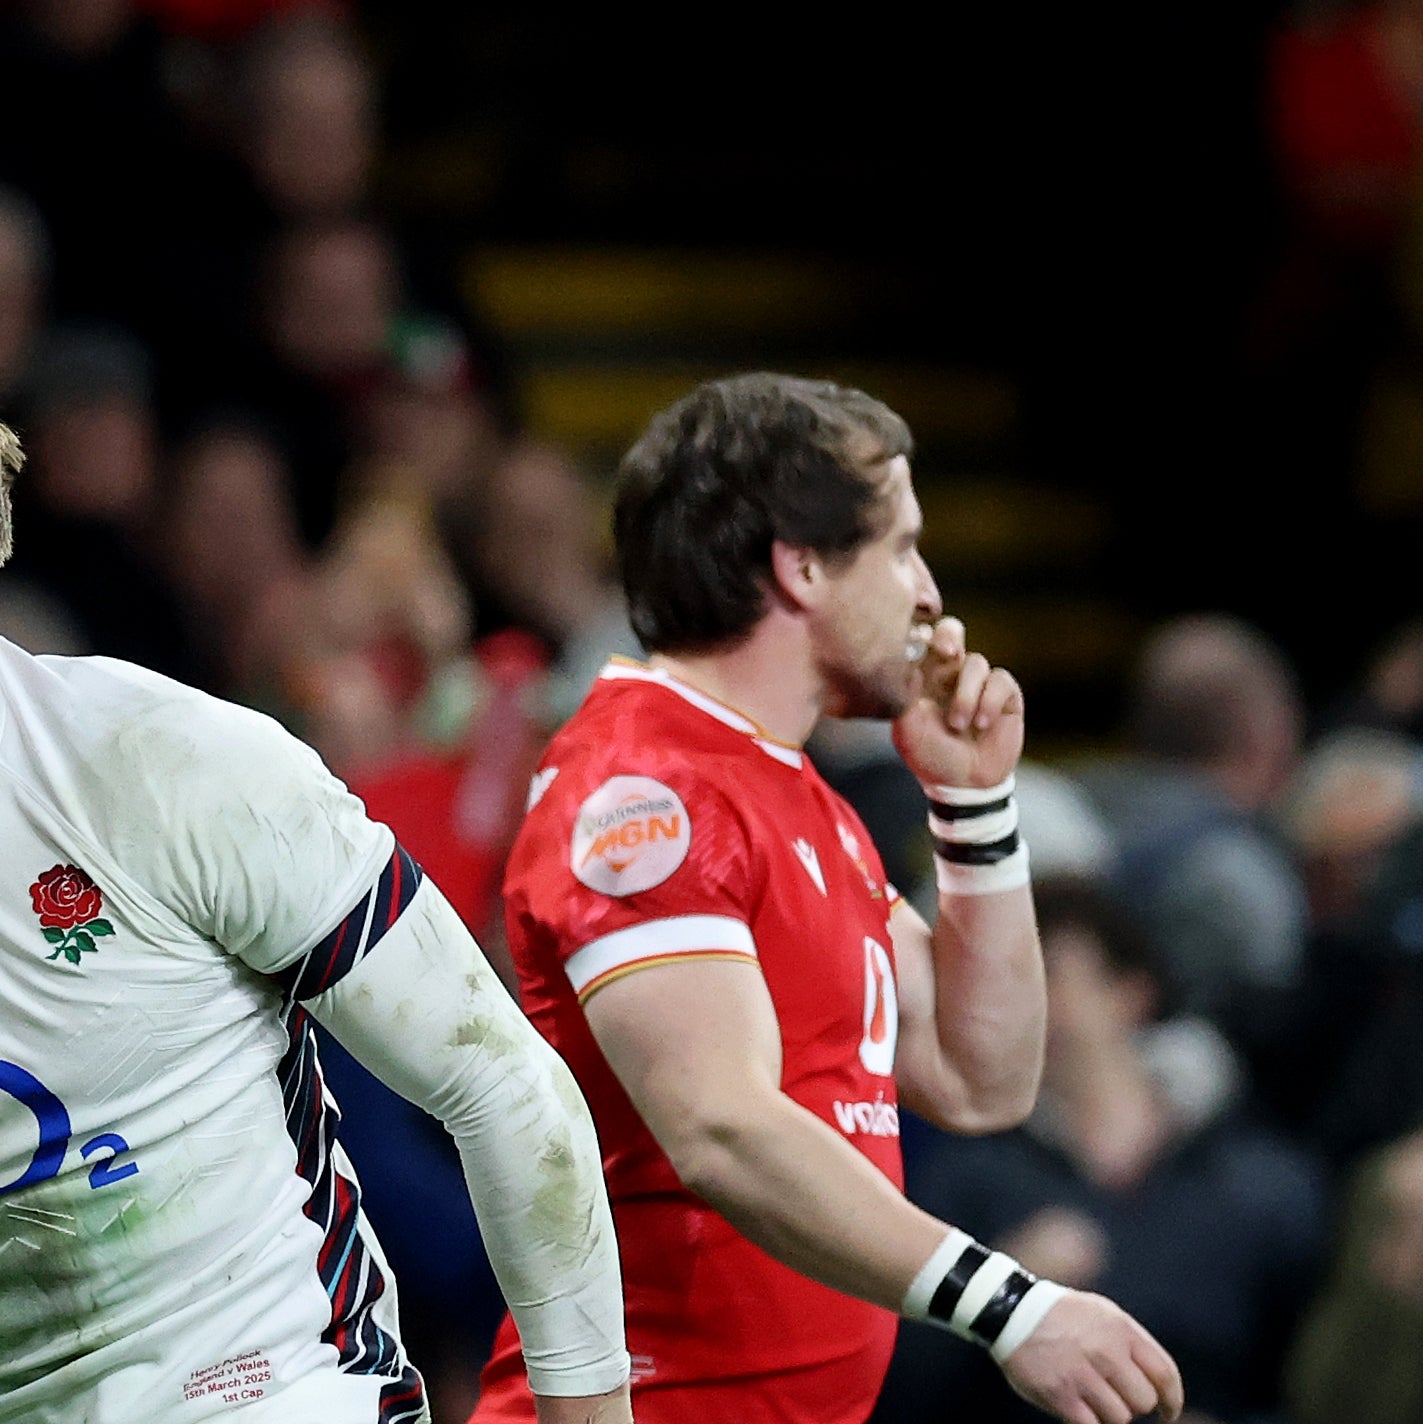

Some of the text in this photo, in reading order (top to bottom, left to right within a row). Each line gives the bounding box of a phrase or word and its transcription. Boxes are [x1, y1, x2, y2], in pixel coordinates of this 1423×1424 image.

[183, 1358, 271, 1392] England v Wales
[190, 1363, 222, 1380] Henry
[184, 1370, 272, 1401] 15th March 2025
[222, 1387, 264, 1403] 1st Cap
